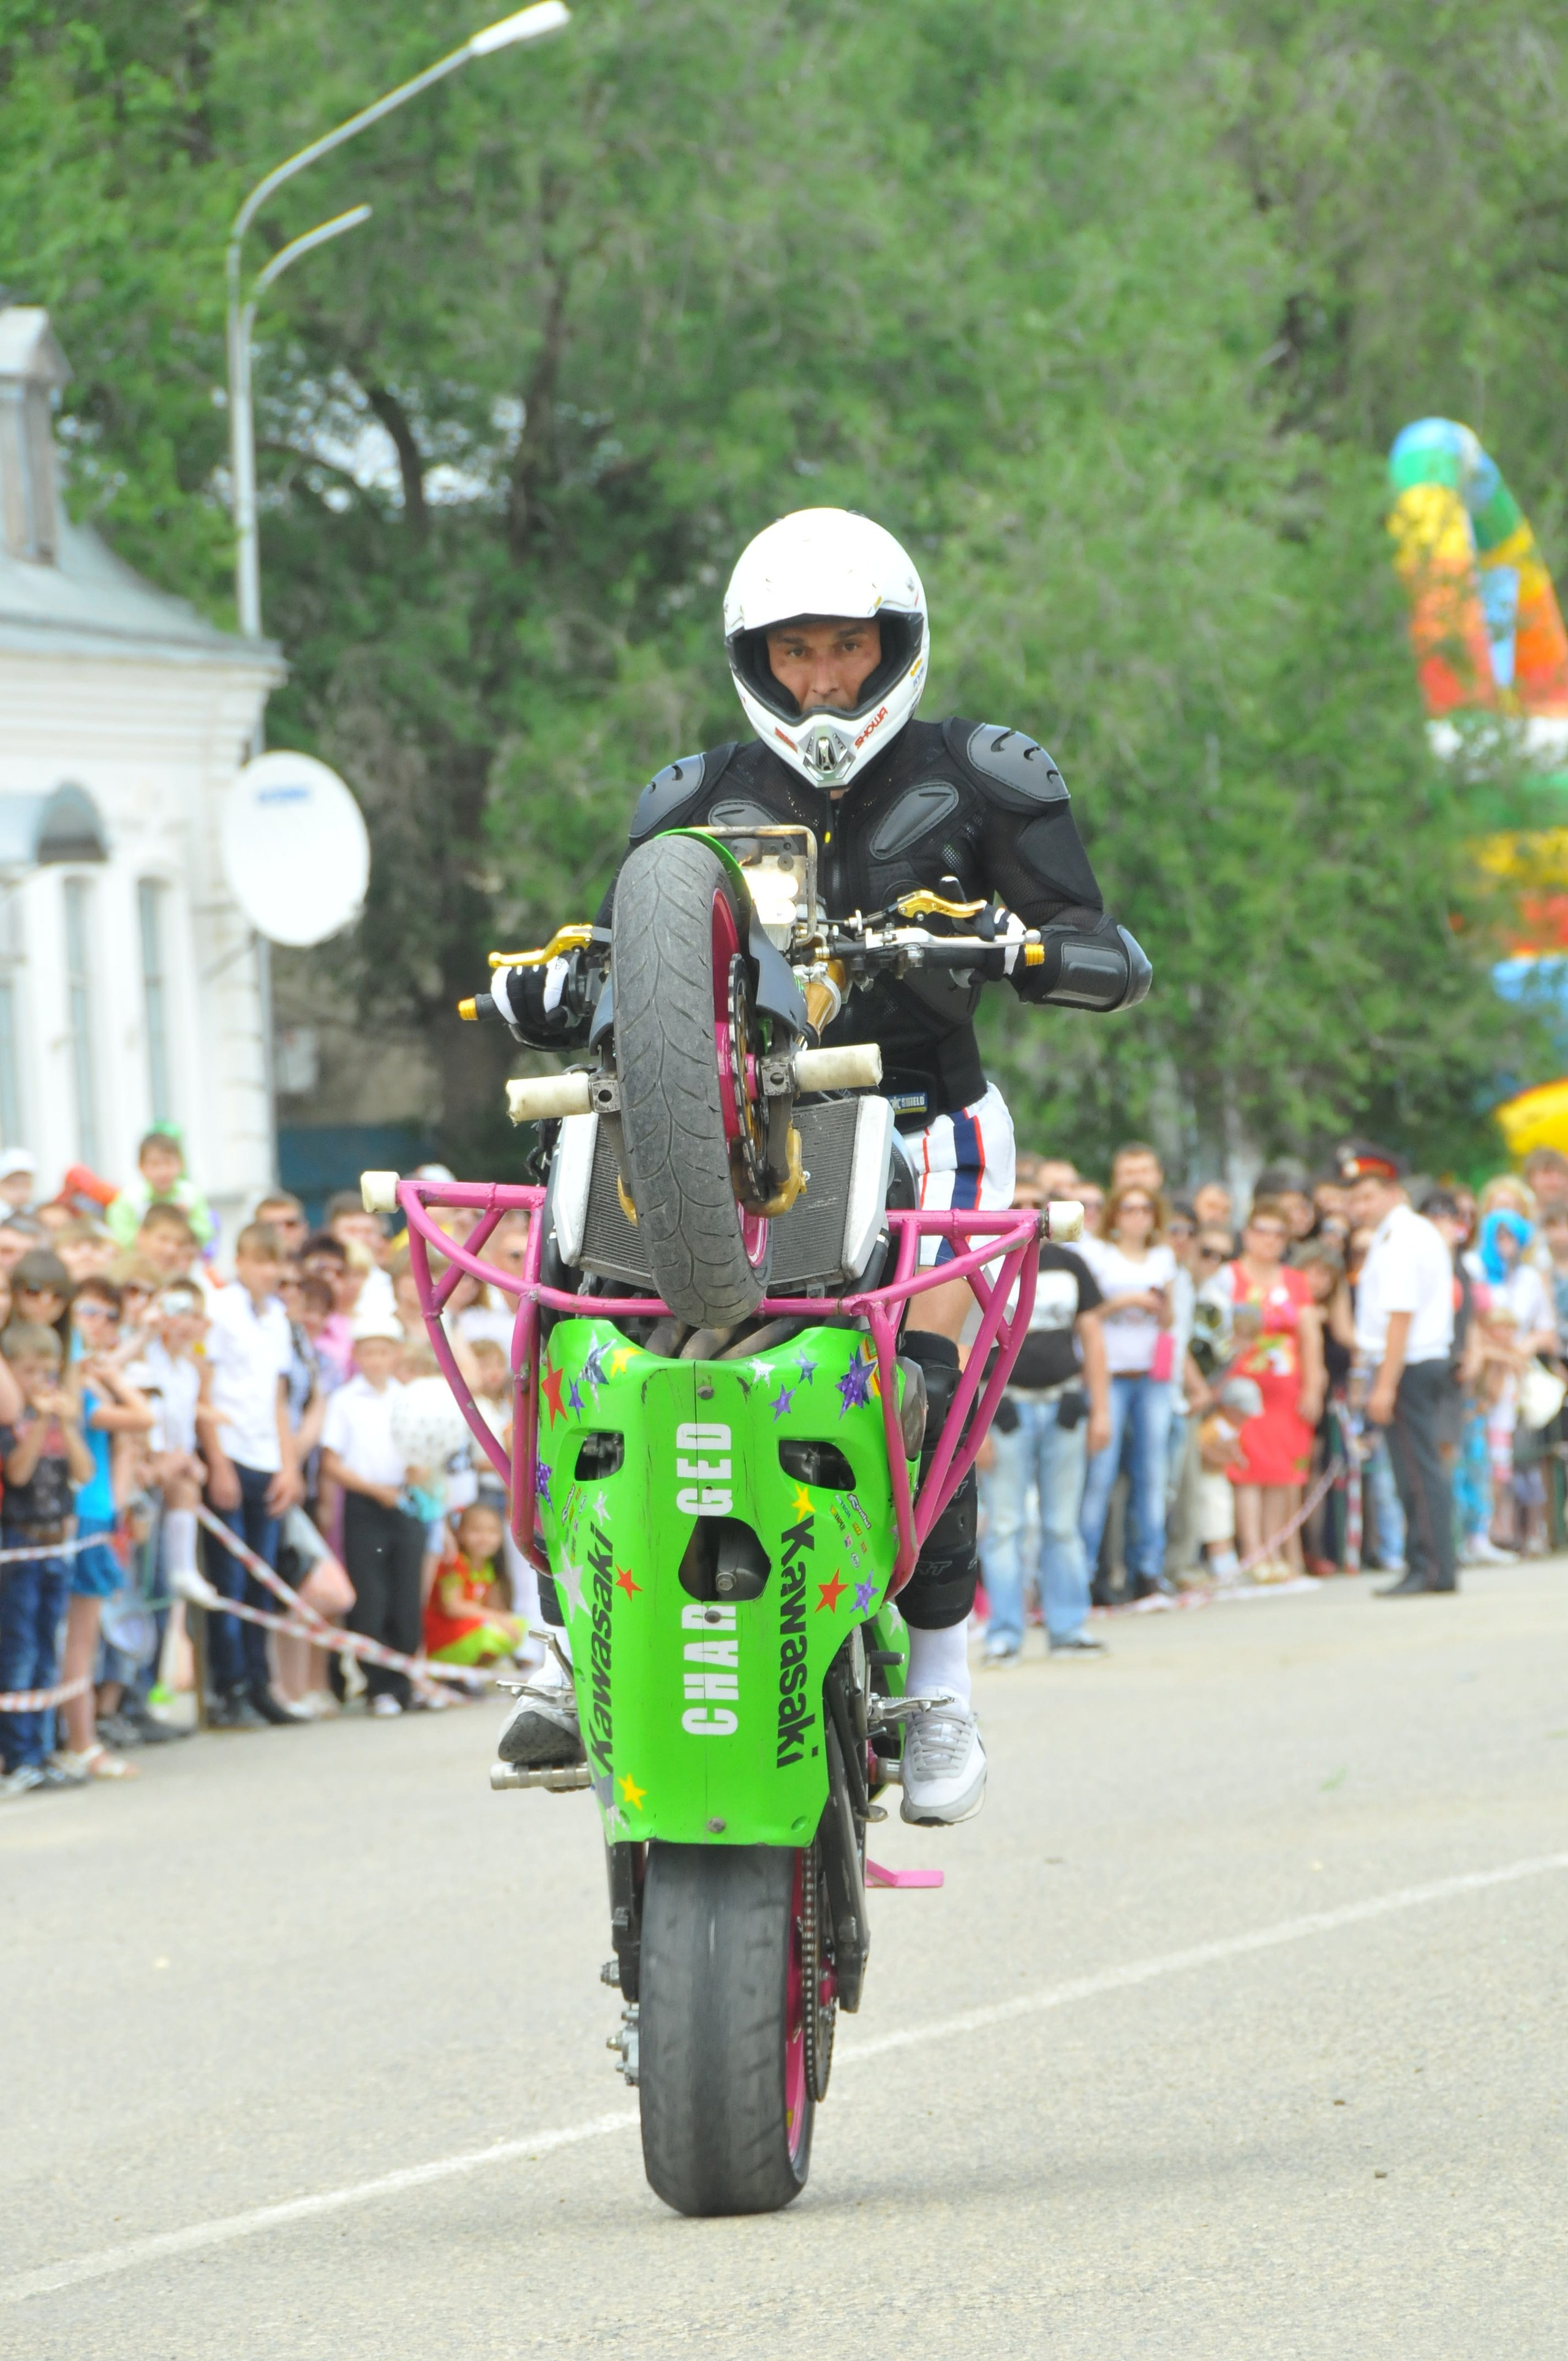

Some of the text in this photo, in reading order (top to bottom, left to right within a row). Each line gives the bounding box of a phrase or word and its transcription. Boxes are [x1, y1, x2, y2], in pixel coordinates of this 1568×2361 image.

[855, 706, 888, 749] SHOWA
[902, 1096, 925, 1108] SHIELD
[587, 1520, 614, 1774] Kawasaki
[776, 1514, 819, 1769] Kawasaki
